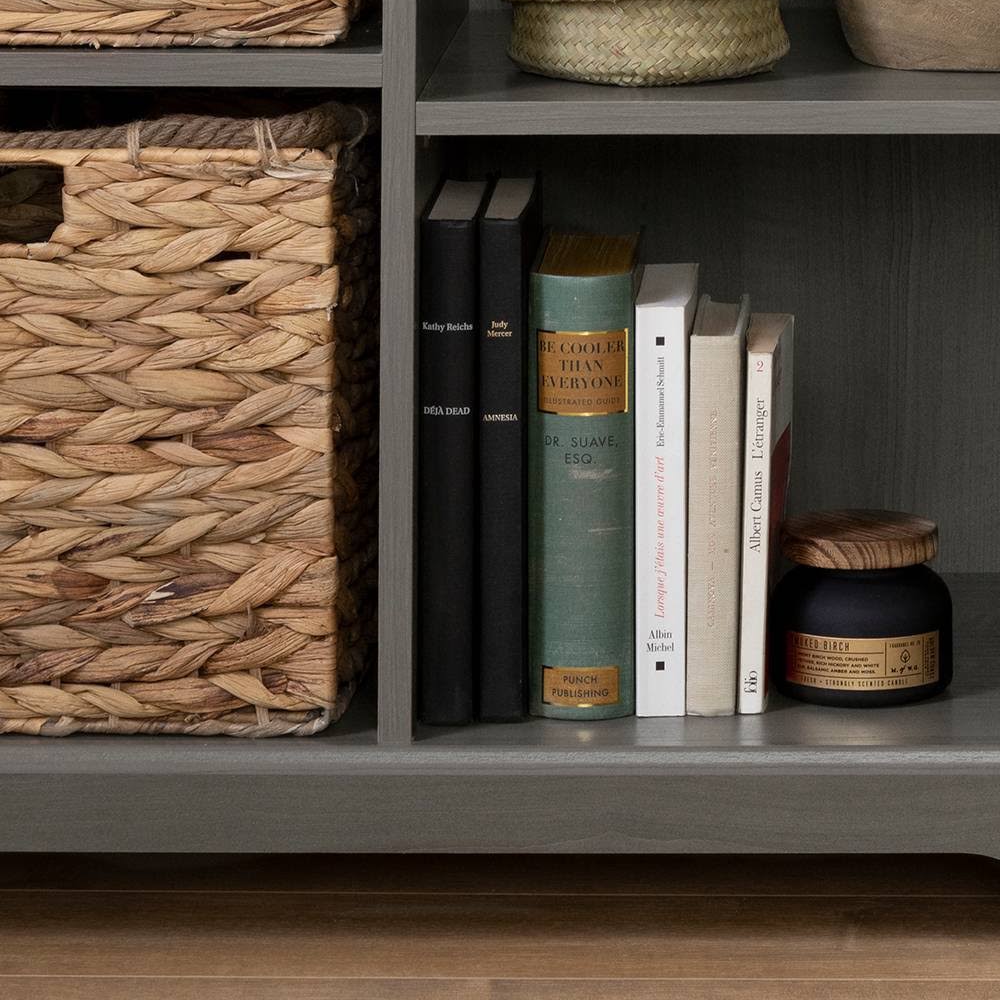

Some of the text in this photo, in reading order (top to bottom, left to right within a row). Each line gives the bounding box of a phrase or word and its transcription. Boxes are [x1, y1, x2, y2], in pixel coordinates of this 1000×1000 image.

[422, 322, 474, 332] Kathy Reichs
[492, 320, 508, 330] Judy
[487, 330, 512, 338] Mercer
[539, 340, 624, 354] BE COOLER
[558, 360, 604, 372] THAN
[756, 360, 764, 372] 2
[542, 376, 623, 390] EVERYONE
[656, 356, 665, 448] Eric-Emmanuel Schmitt
[424, 405, 471, 416] DÉJÀ DEAD
[482, 413, 518, 422] AMNESIA
[545, 436, 619, 448] DR. SUAVE,
[564, 453, 597, 465] ESQ.
[750, 397, 768, 553] Albert Camus L'étranger
[654, 456, 668, 618] Lorsque j'étais une œuvre d'art
[648, 630, 672, 640] Albin
[646, 643, 674, 652] Michel
[823, 640, 850, 652] BIRCH
[563, 675, 598, 685] PUNCH
[552, 688, 610, 698] PUBLISHING
